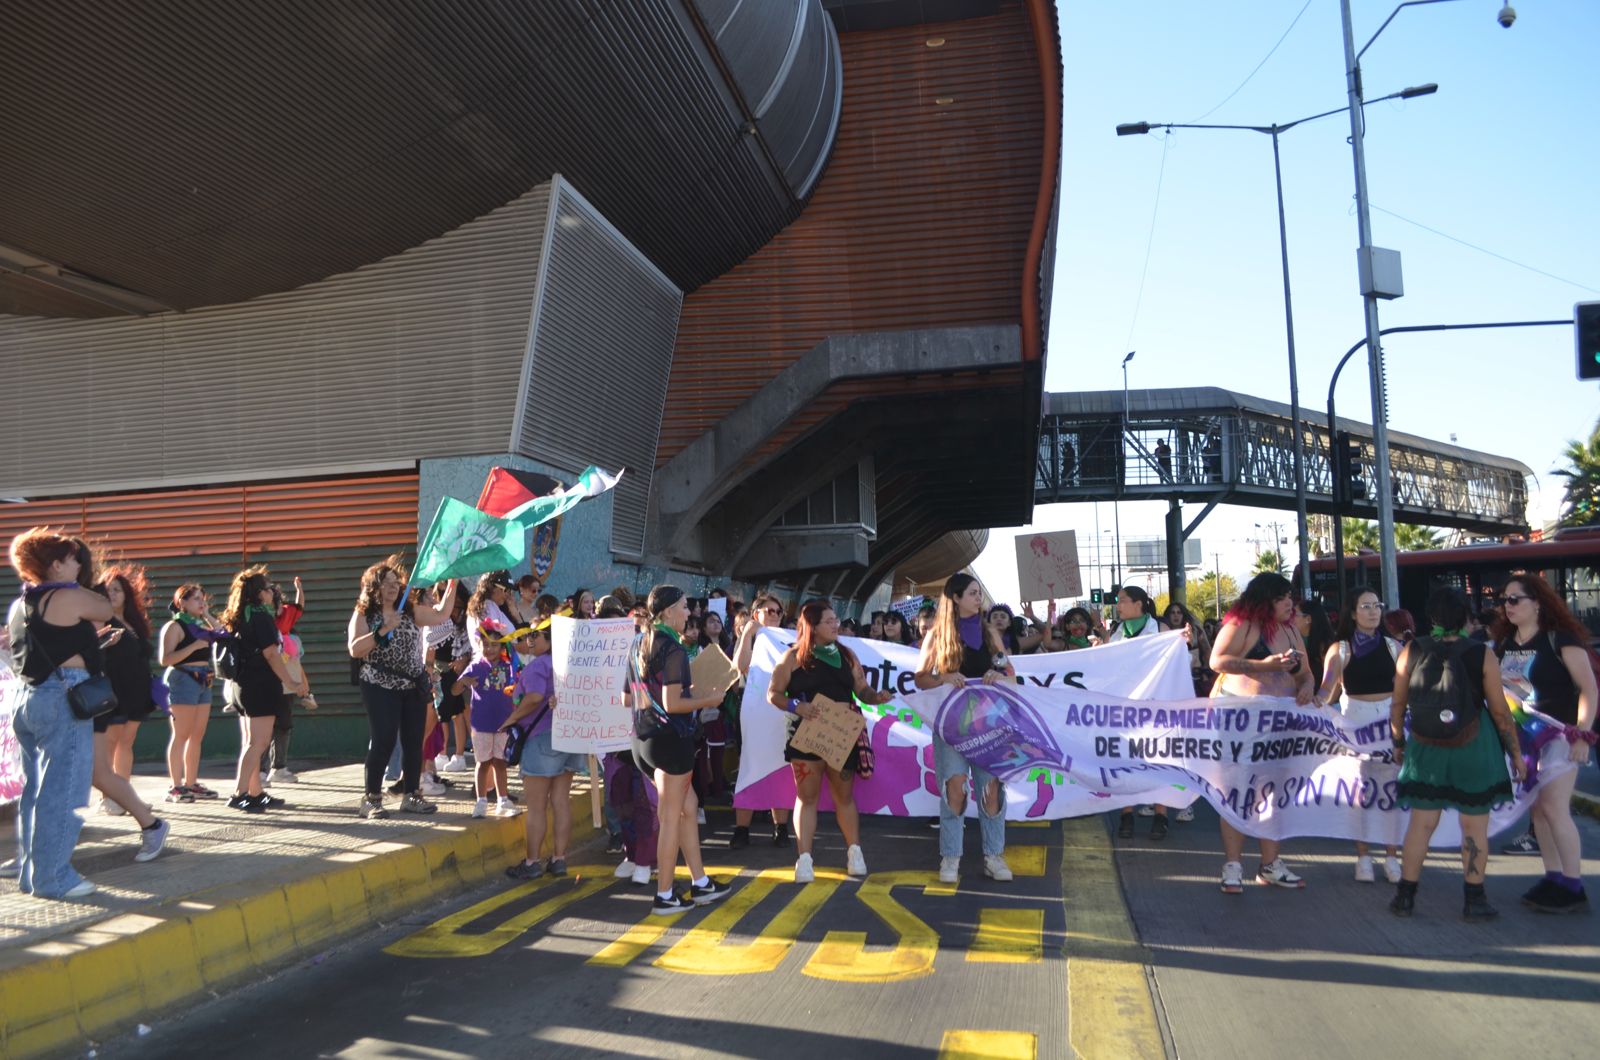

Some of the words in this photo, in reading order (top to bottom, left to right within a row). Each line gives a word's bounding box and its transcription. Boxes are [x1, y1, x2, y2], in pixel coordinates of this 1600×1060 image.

[568, 637, 628, 653] NOGALES
[555, 691, 603, 708] ELITOS
[610, 695, 623, 705] D
[1065, 703, 1250, 732] ACUERPAMIENTO
[555, 724, 629, 740] SEXUALES
[1095, 736, 1121, 758] DE
[1128, 737, 1223, 761] MUJERES
[1230, 741, 1244, 763] Y
[1277, 774, 1326, 810] SIN
